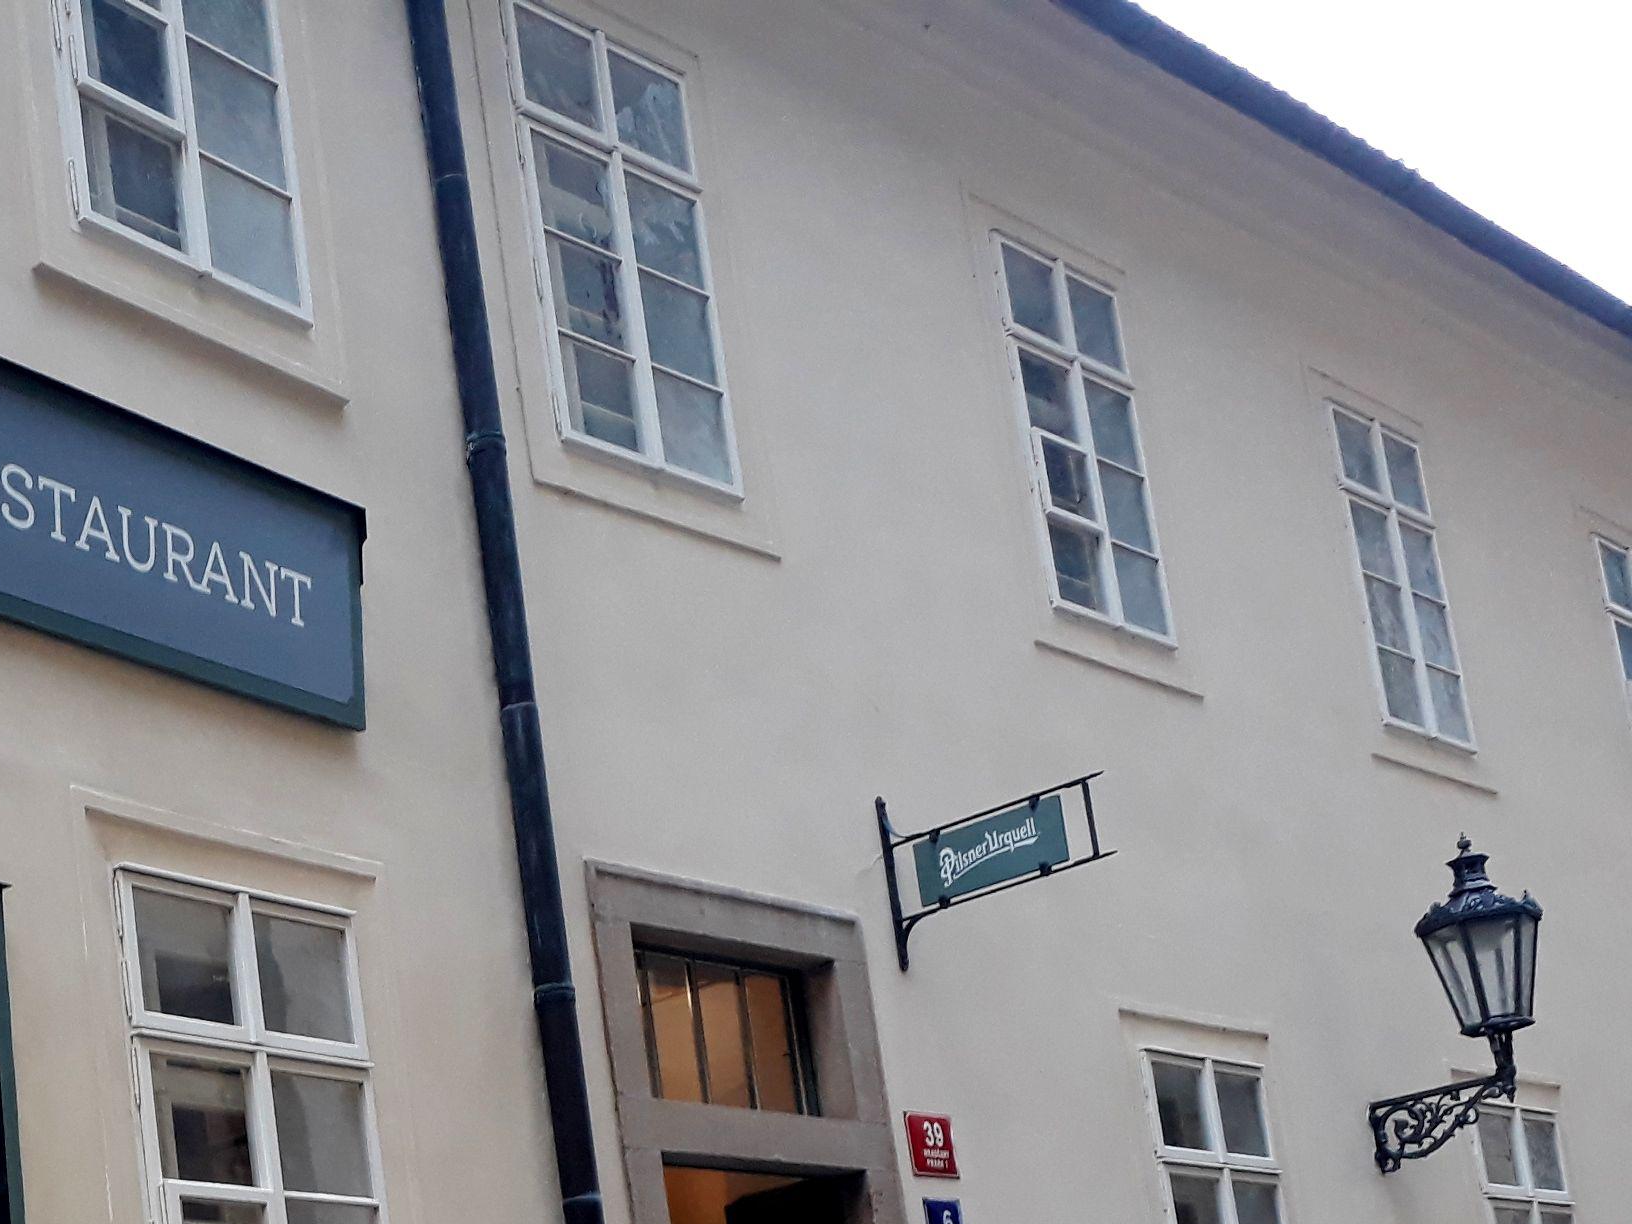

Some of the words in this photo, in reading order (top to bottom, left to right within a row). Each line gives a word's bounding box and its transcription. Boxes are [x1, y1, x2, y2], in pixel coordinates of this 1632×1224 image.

[939, 841, 987, 887] Pilsner
[985, 817, 1038, 852] Urquell
[923, 1120, 944, 1148] 39
